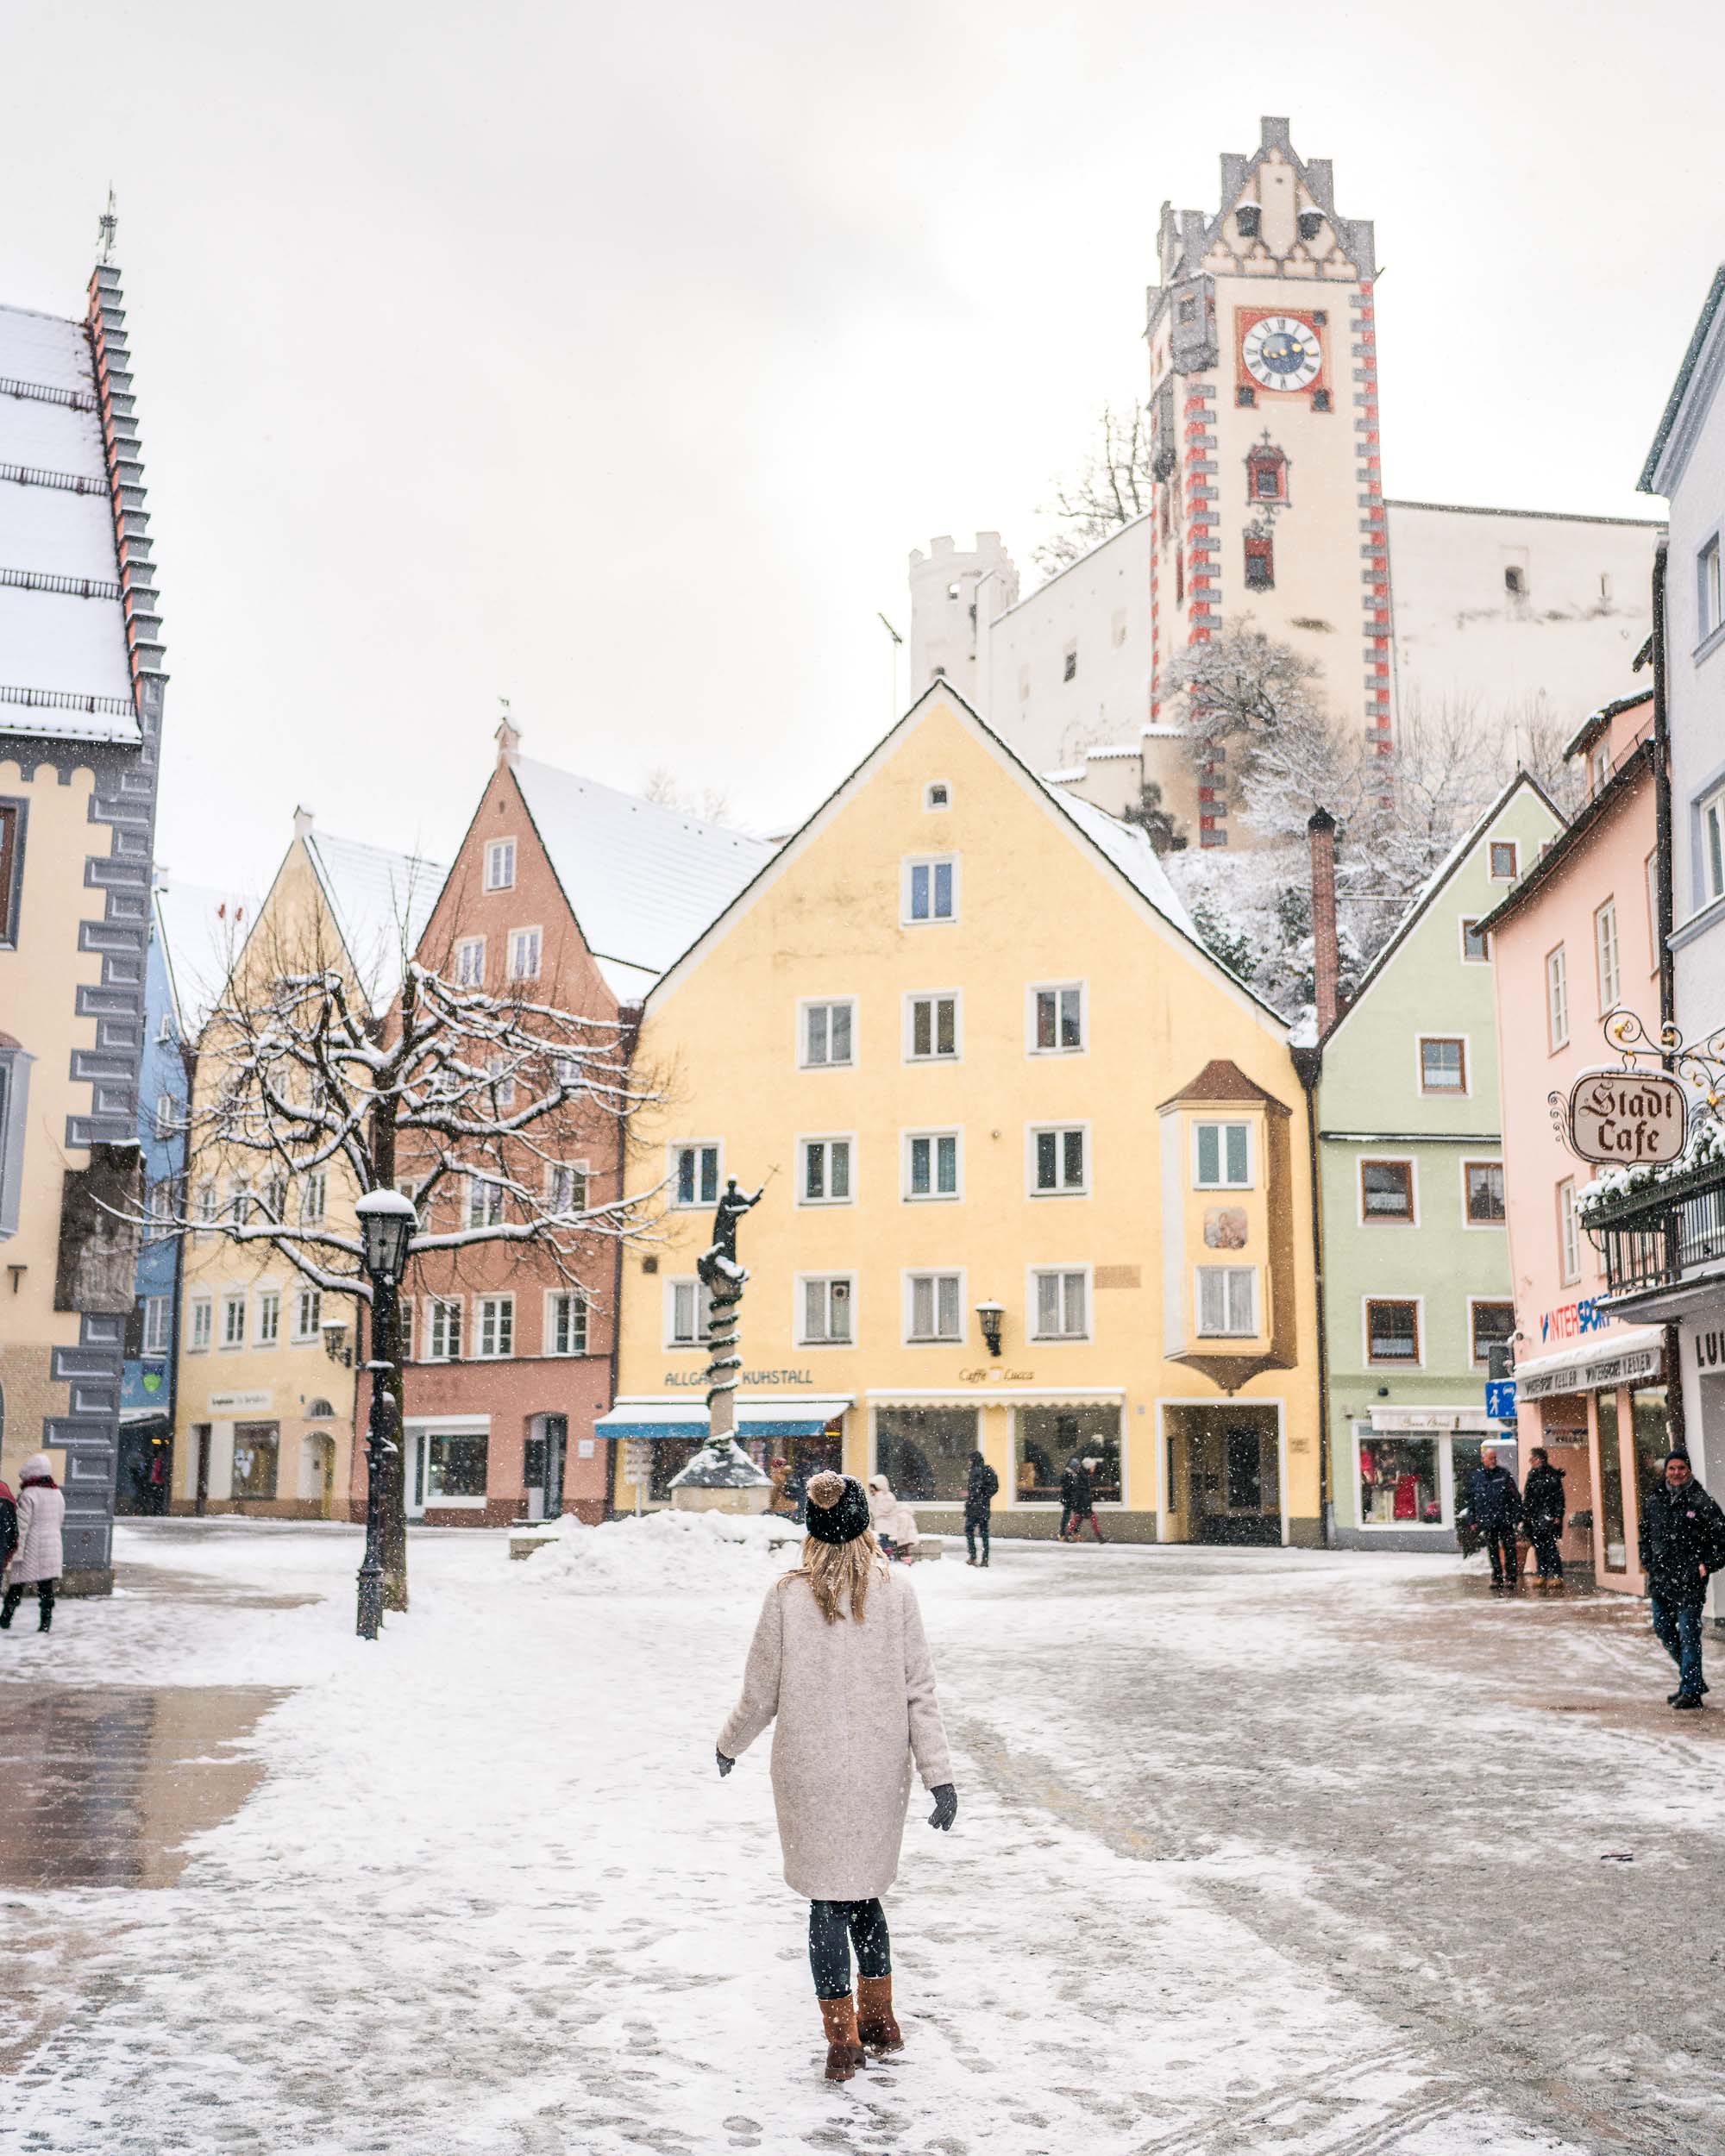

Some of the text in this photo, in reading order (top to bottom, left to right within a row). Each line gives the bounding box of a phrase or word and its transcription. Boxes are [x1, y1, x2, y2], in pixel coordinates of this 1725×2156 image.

[1578, 1081, 1673, 1119] Stadt
[1598, 1119, 1659, 1159] Cafe
[743, 1369, 813, 1385] KUHSTALL
